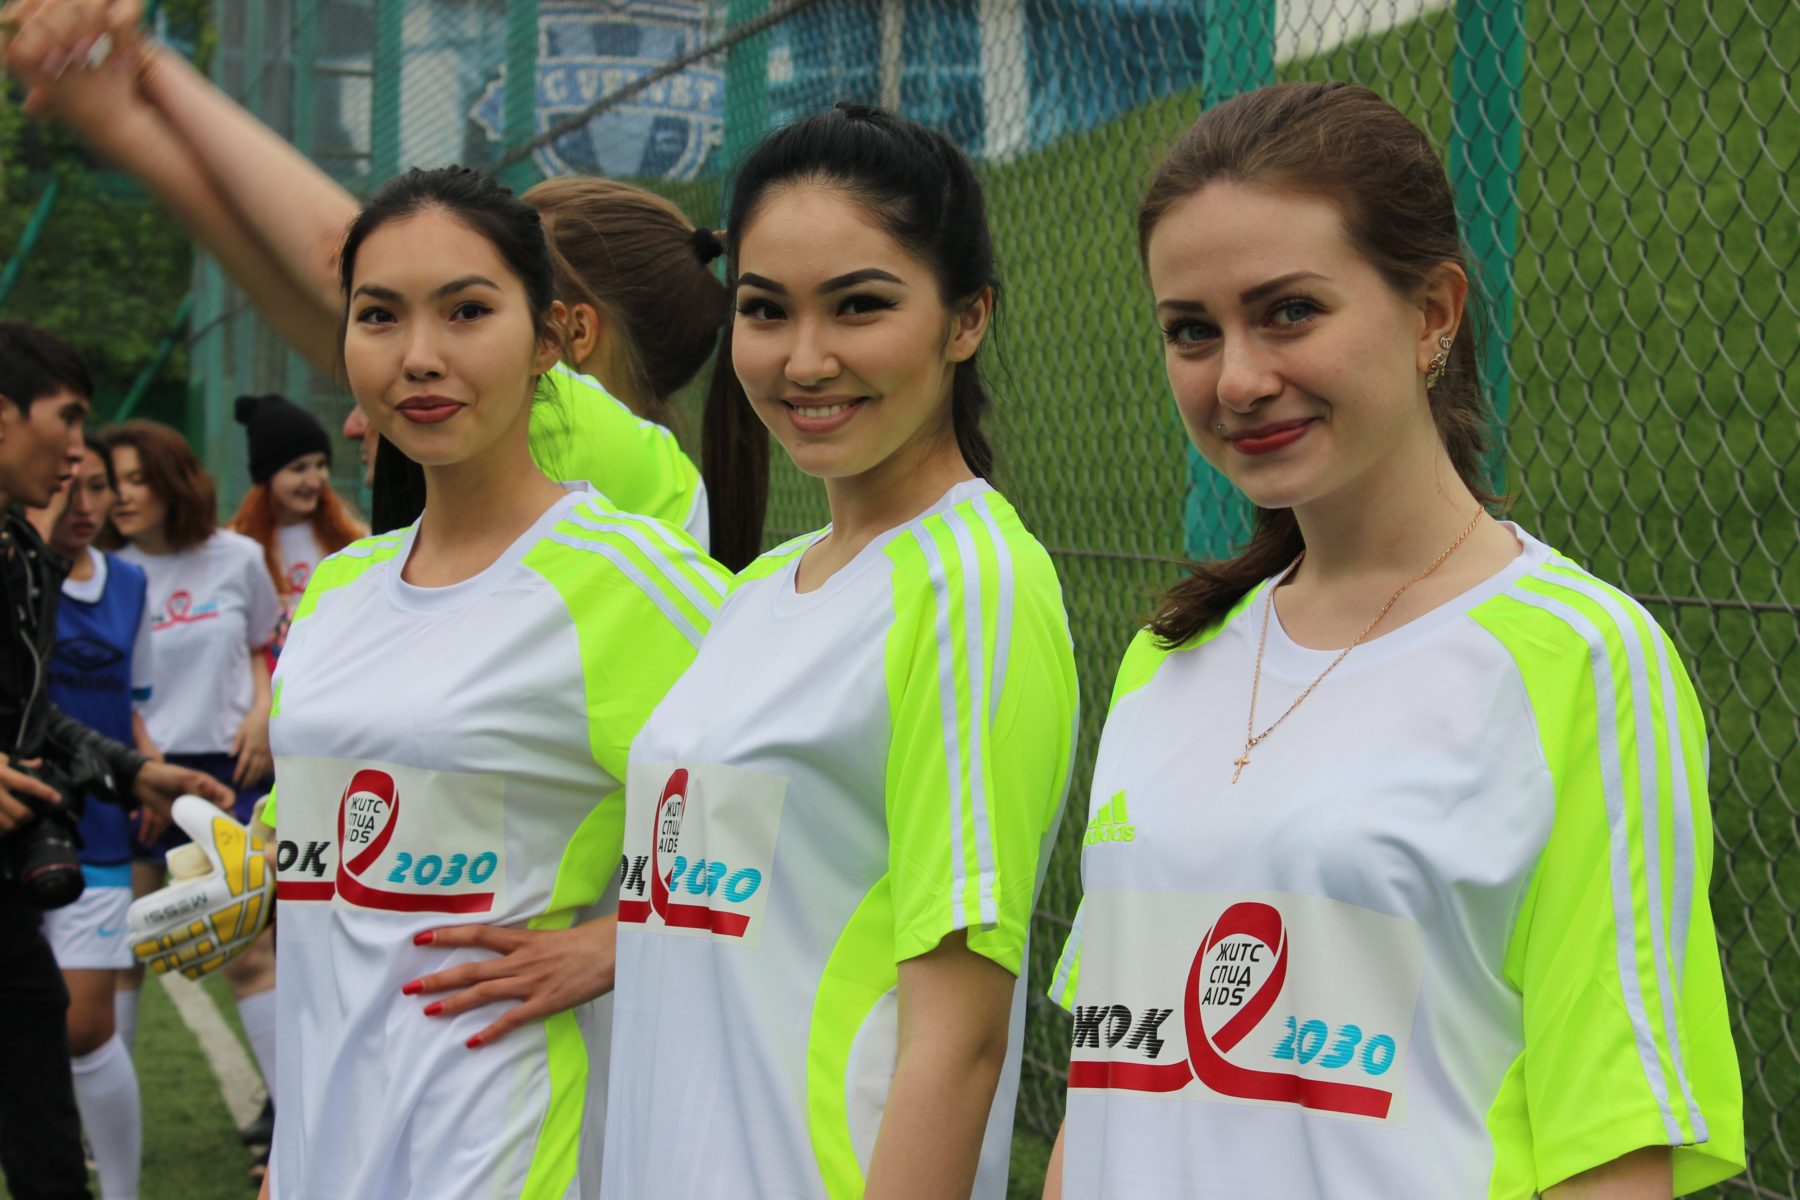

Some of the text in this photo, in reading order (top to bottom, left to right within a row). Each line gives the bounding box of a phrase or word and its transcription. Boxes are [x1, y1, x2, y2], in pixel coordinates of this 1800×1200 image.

[665, 801, 682, 817] ЖИТ
[385, 851, 498, 886] 2030
[1201, 986, 1246, 1006] AIDS
[1268, 1015, 1396, 1076] 2030
